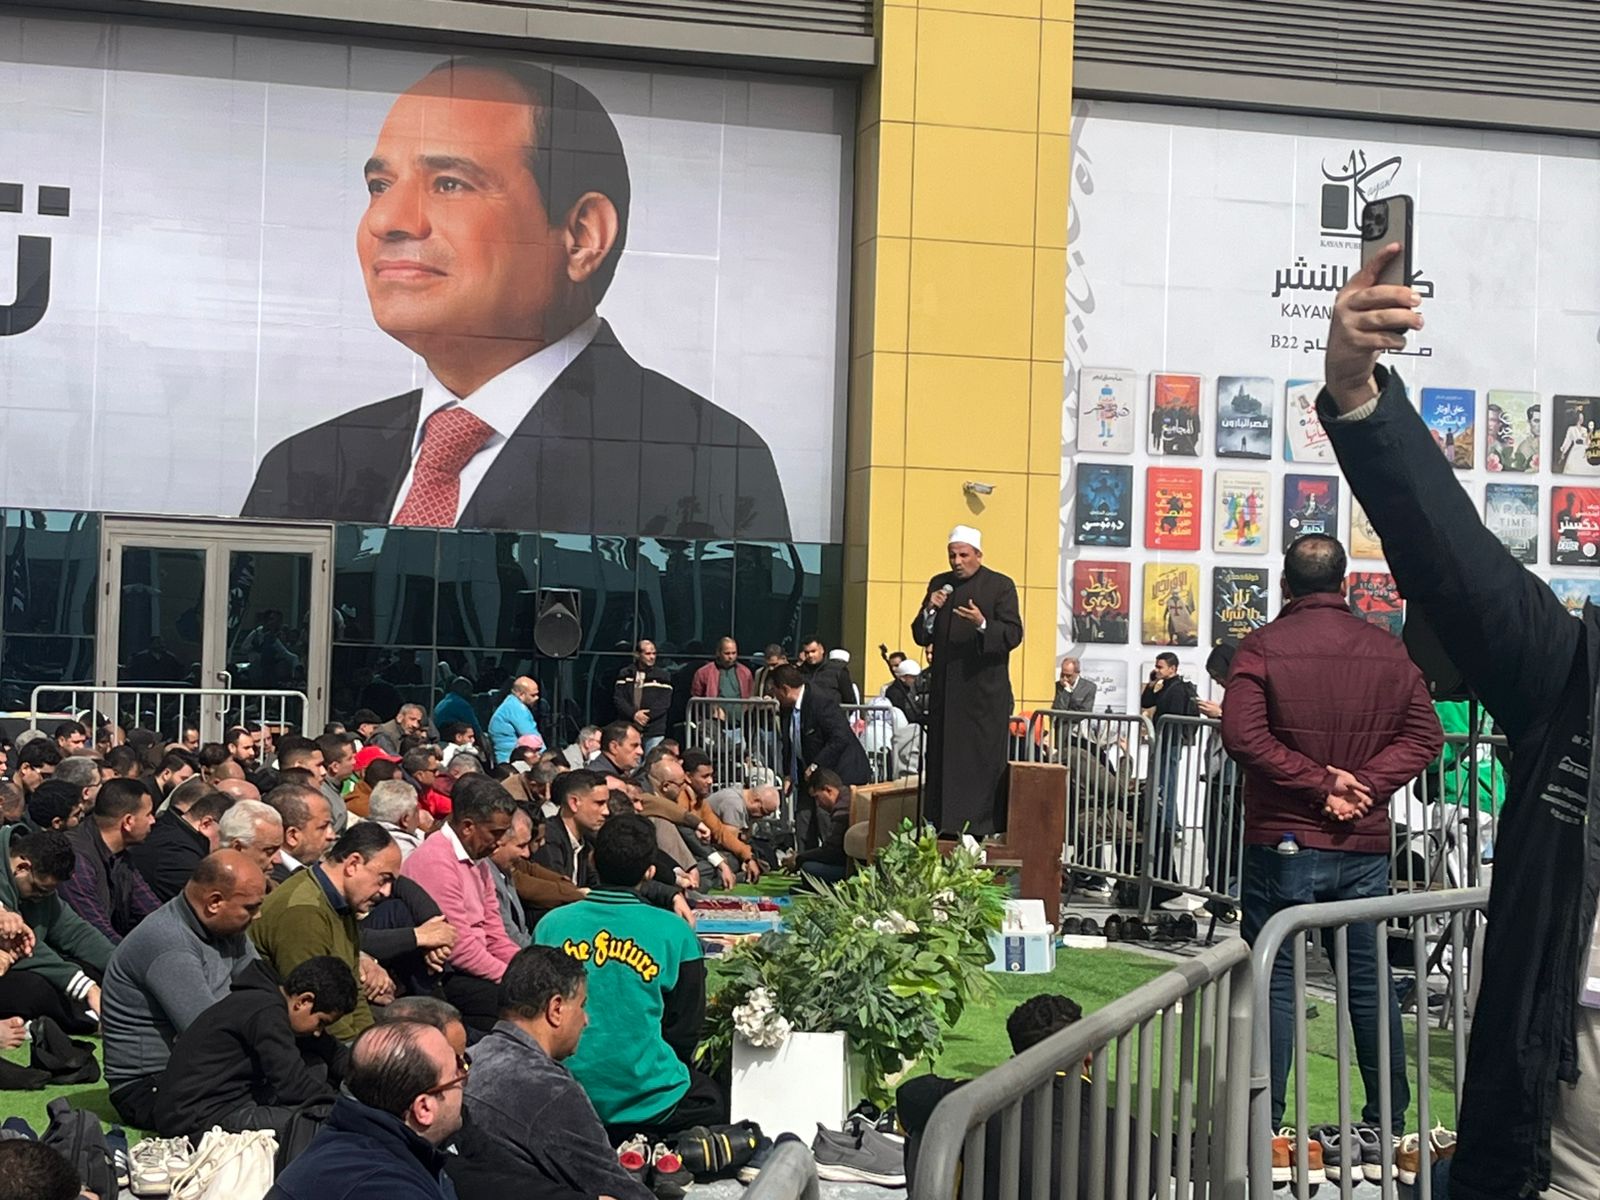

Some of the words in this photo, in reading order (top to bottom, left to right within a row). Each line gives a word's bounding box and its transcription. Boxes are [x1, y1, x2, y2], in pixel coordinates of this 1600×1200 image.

[1320, 240, 1344, 248] KAYAN
[1271, 256, 1348, 298] للنشر
[1281, 304, 1332, 319] KAYAN
[1271, 335, 1298, 349] B22
[1500, 518, 1527, 527] TIME
[563, 938, 590, 962] he
[593, 928, 660, 982] Future
